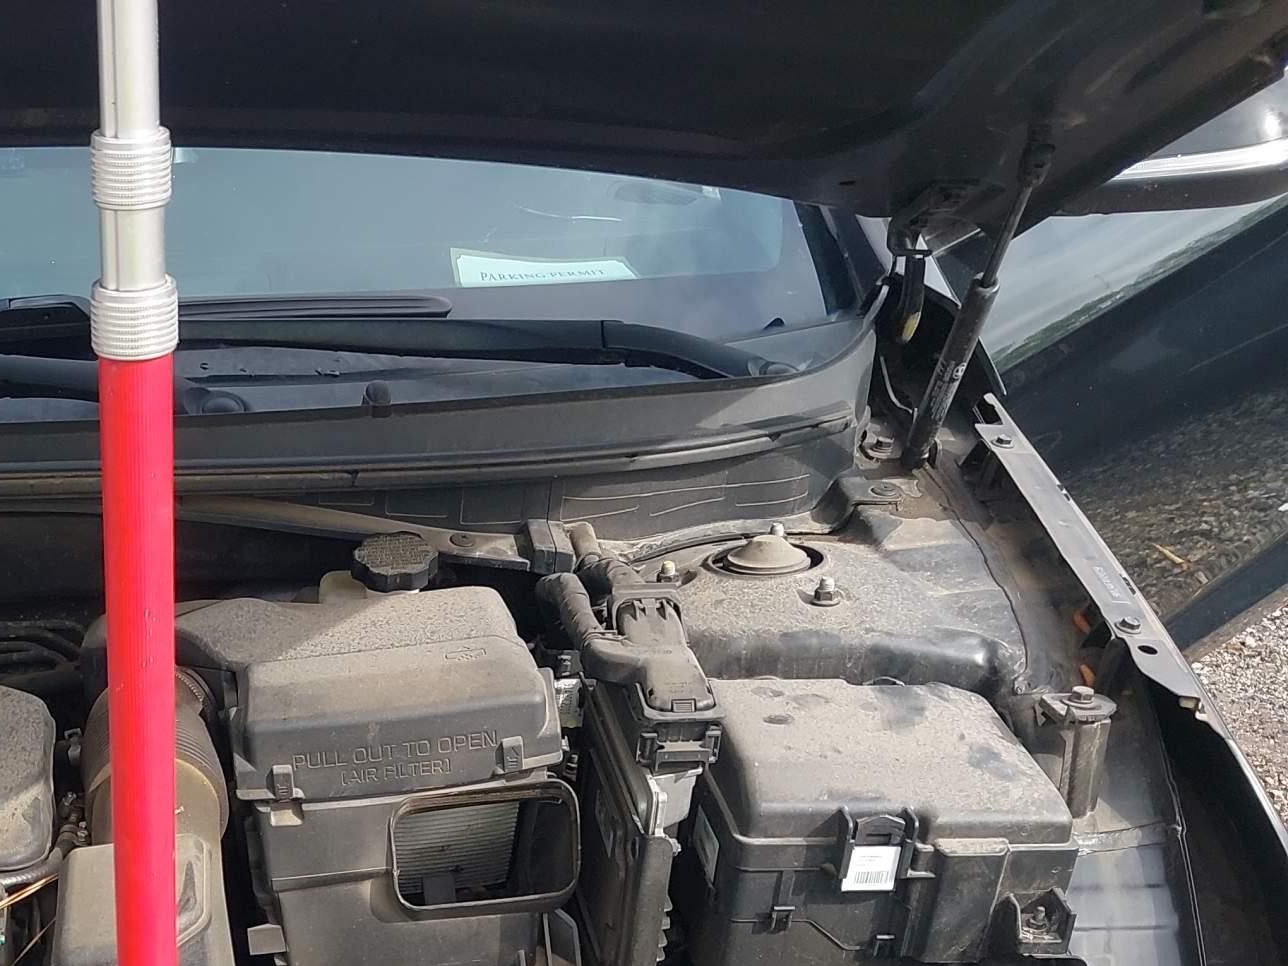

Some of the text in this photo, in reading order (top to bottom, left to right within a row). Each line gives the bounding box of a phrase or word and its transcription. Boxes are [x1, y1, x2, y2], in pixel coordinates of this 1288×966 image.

[479, 269, 605, 281] PARKING PERMIT
[292, 729, 497, 772] PULL OUT TO OPEN
